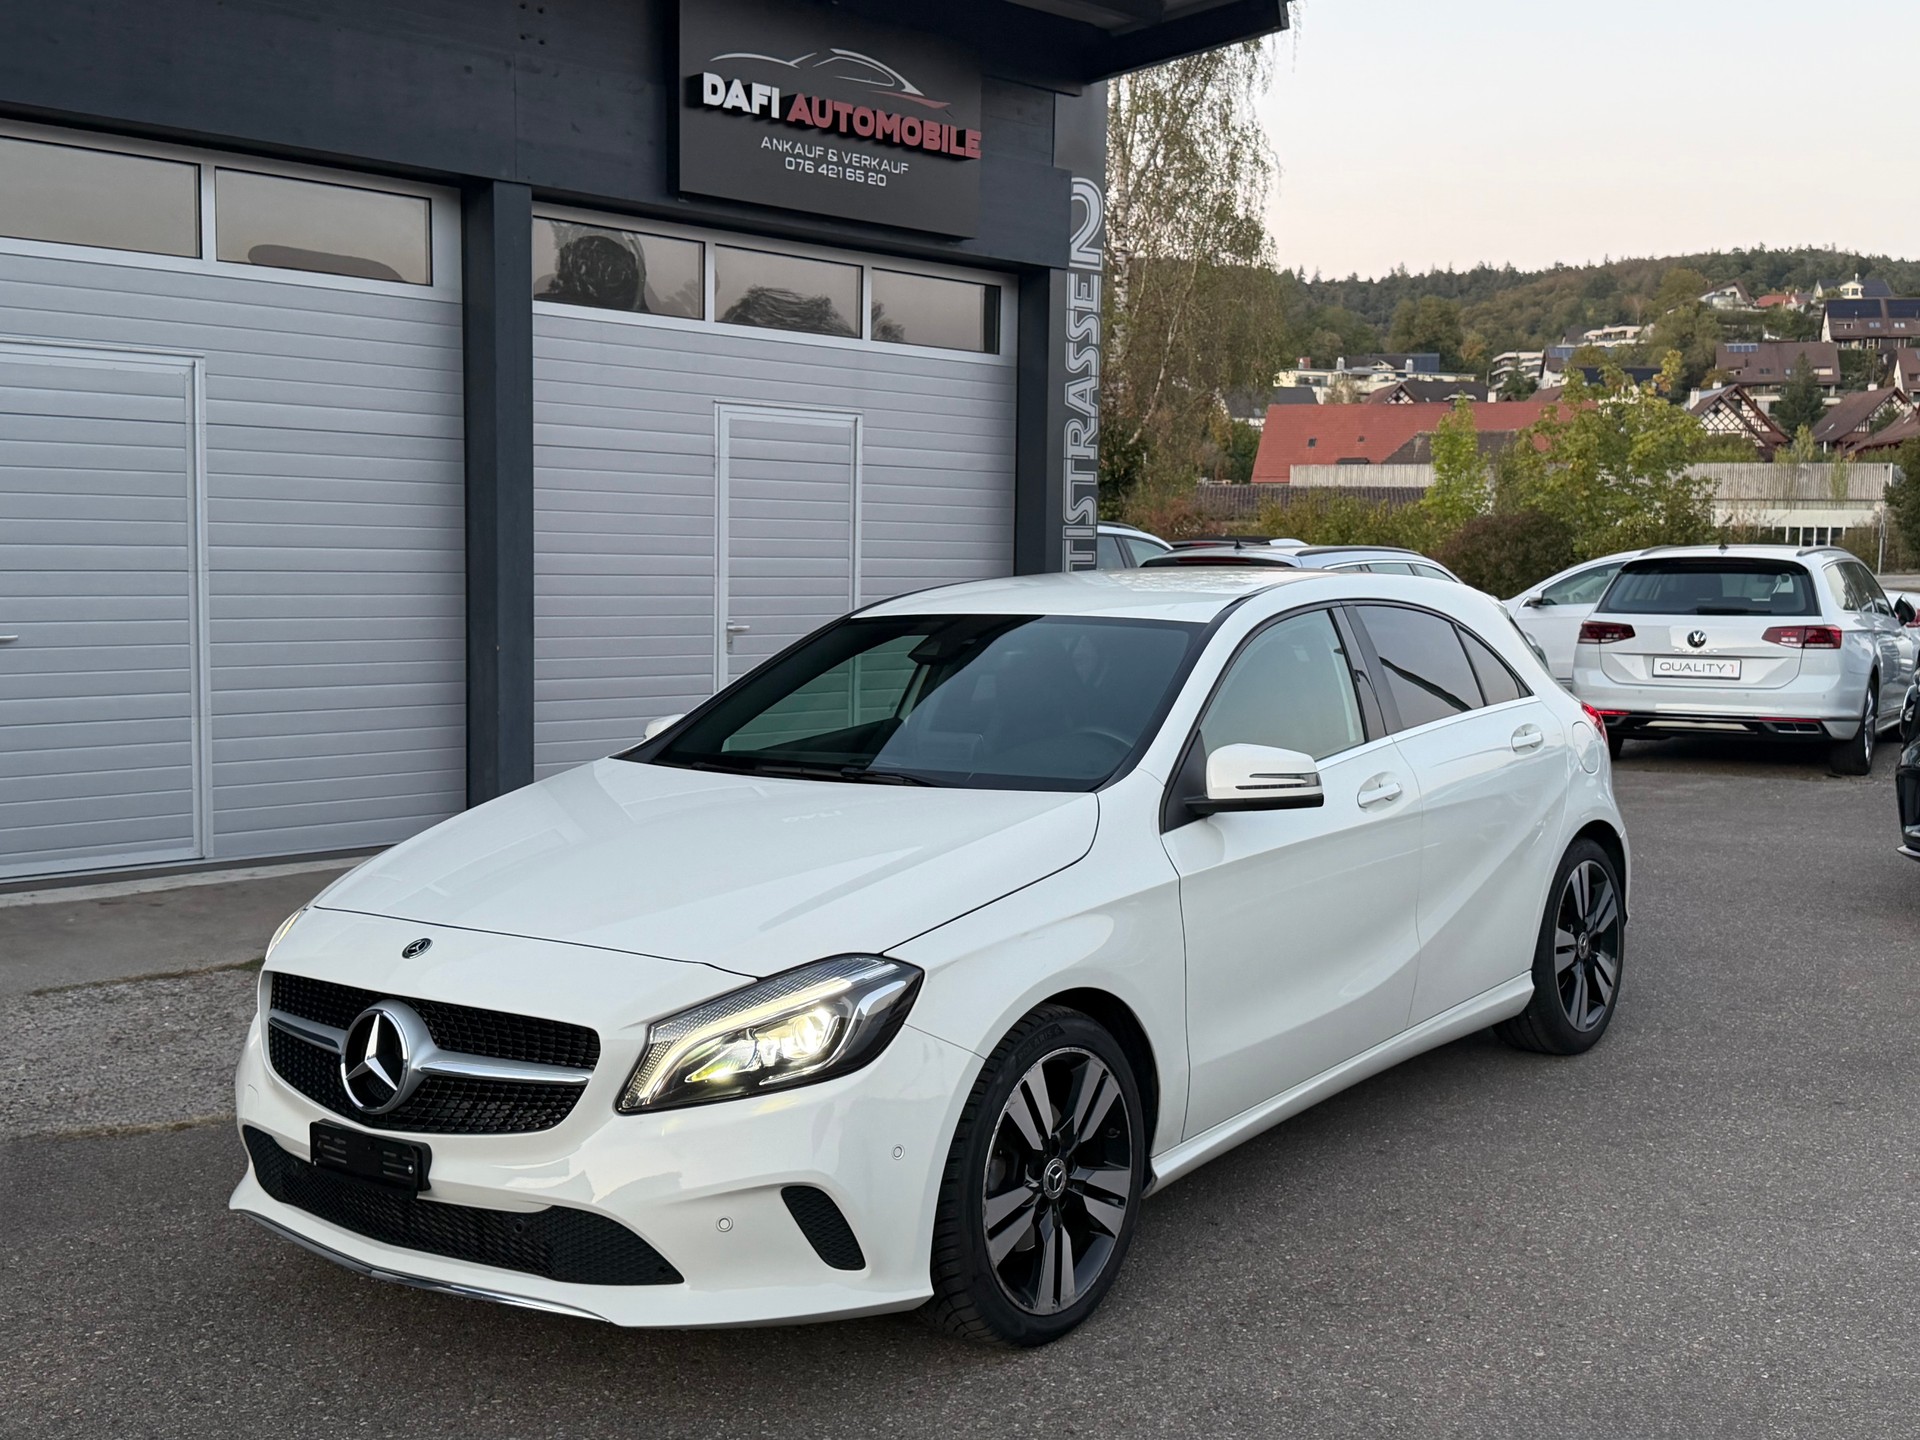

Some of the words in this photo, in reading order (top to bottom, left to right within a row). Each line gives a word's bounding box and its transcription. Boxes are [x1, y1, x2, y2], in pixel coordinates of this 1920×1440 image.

[703, 72, 780, 119] DAFI
[786, 93, 982, 160] AUTOMOBILE
[760, 136, 824, 158] ANKAUF
[827, 149, 838, 162] &
[841, 151, 909, 173] VERKAUF
[785, 157, 815, 174] 076
[867, 172, 887, 187] 20
[1068, 177, 1104, 271] 2
[1659, 662, 1726, 673] QUALITY
[1729, 664, 1735, 673] 1
